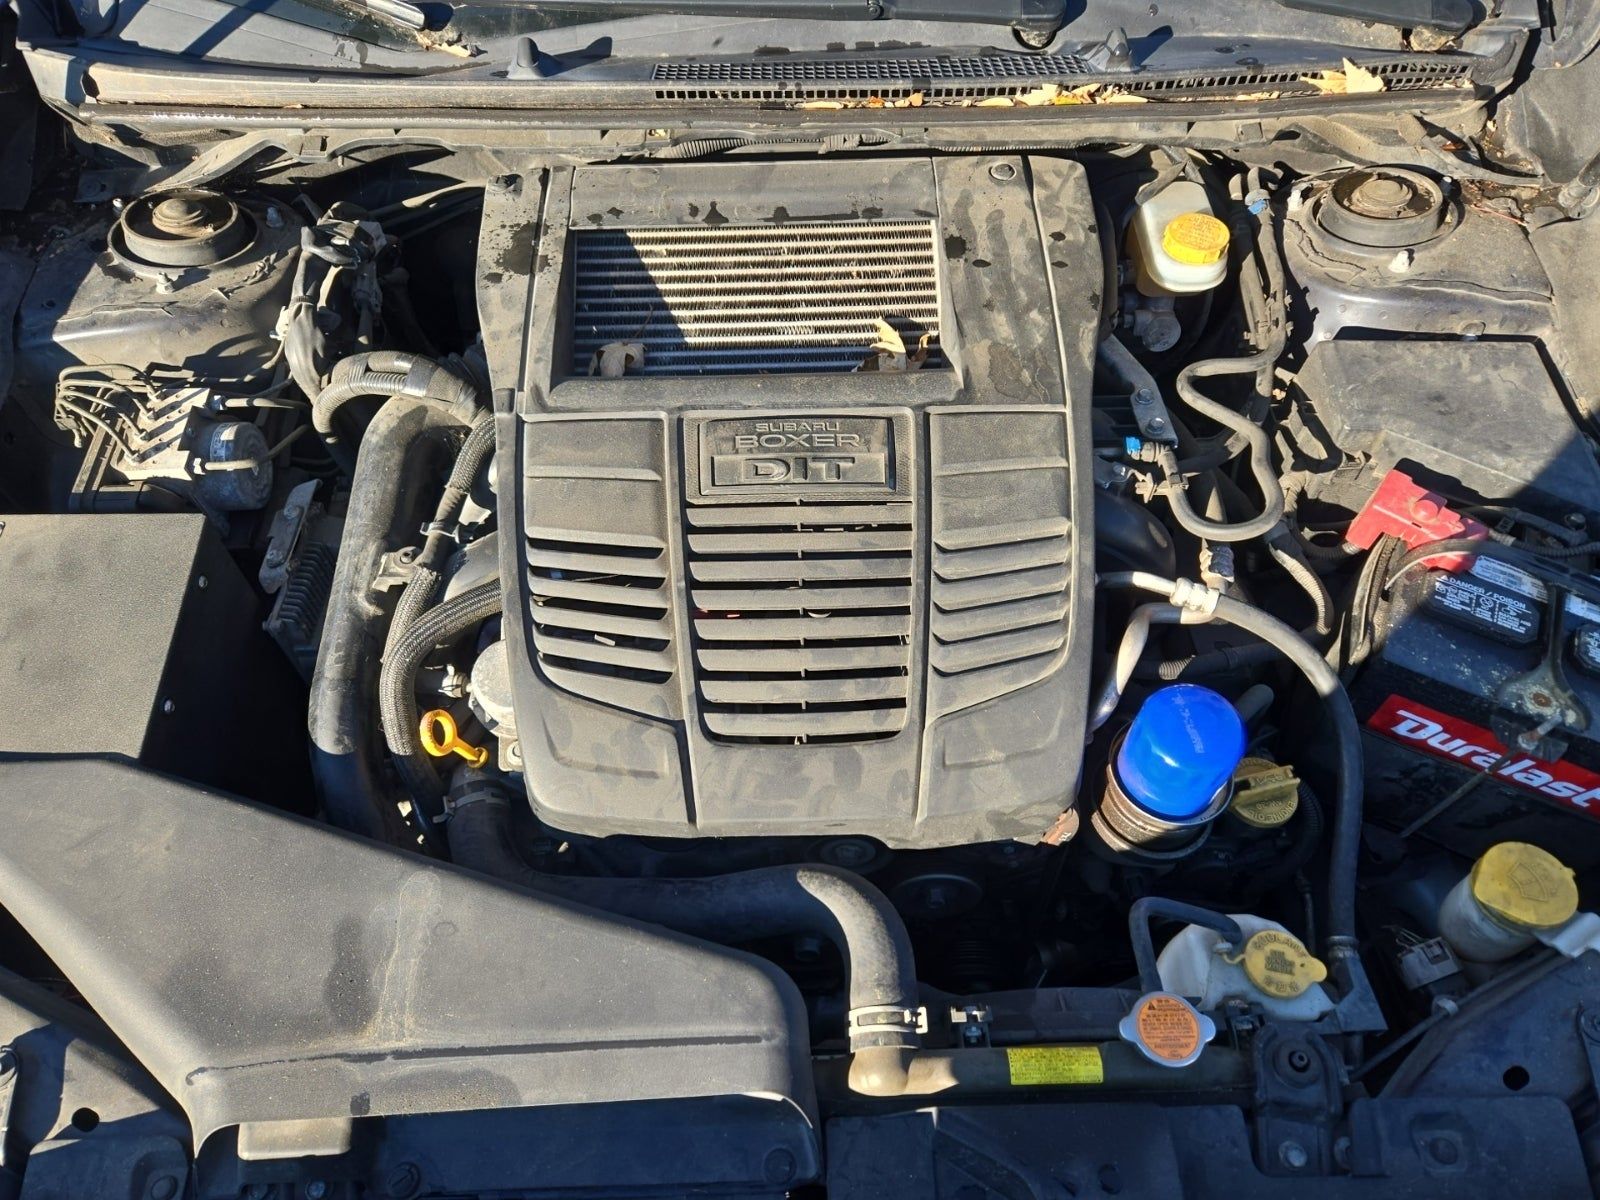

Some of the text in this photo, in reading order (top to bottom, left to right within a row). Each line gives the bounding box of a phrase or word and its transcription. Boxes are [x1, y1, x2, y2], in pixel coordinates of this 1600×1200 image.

[755, 422, 840, 432] SUBARU
[735, 433, 861, 449] BOXER
[742, 457, 856, 481] DIT
[1449, 578, 1485, 595] DANGER
[1493, 593, 1526, 610] POISON
